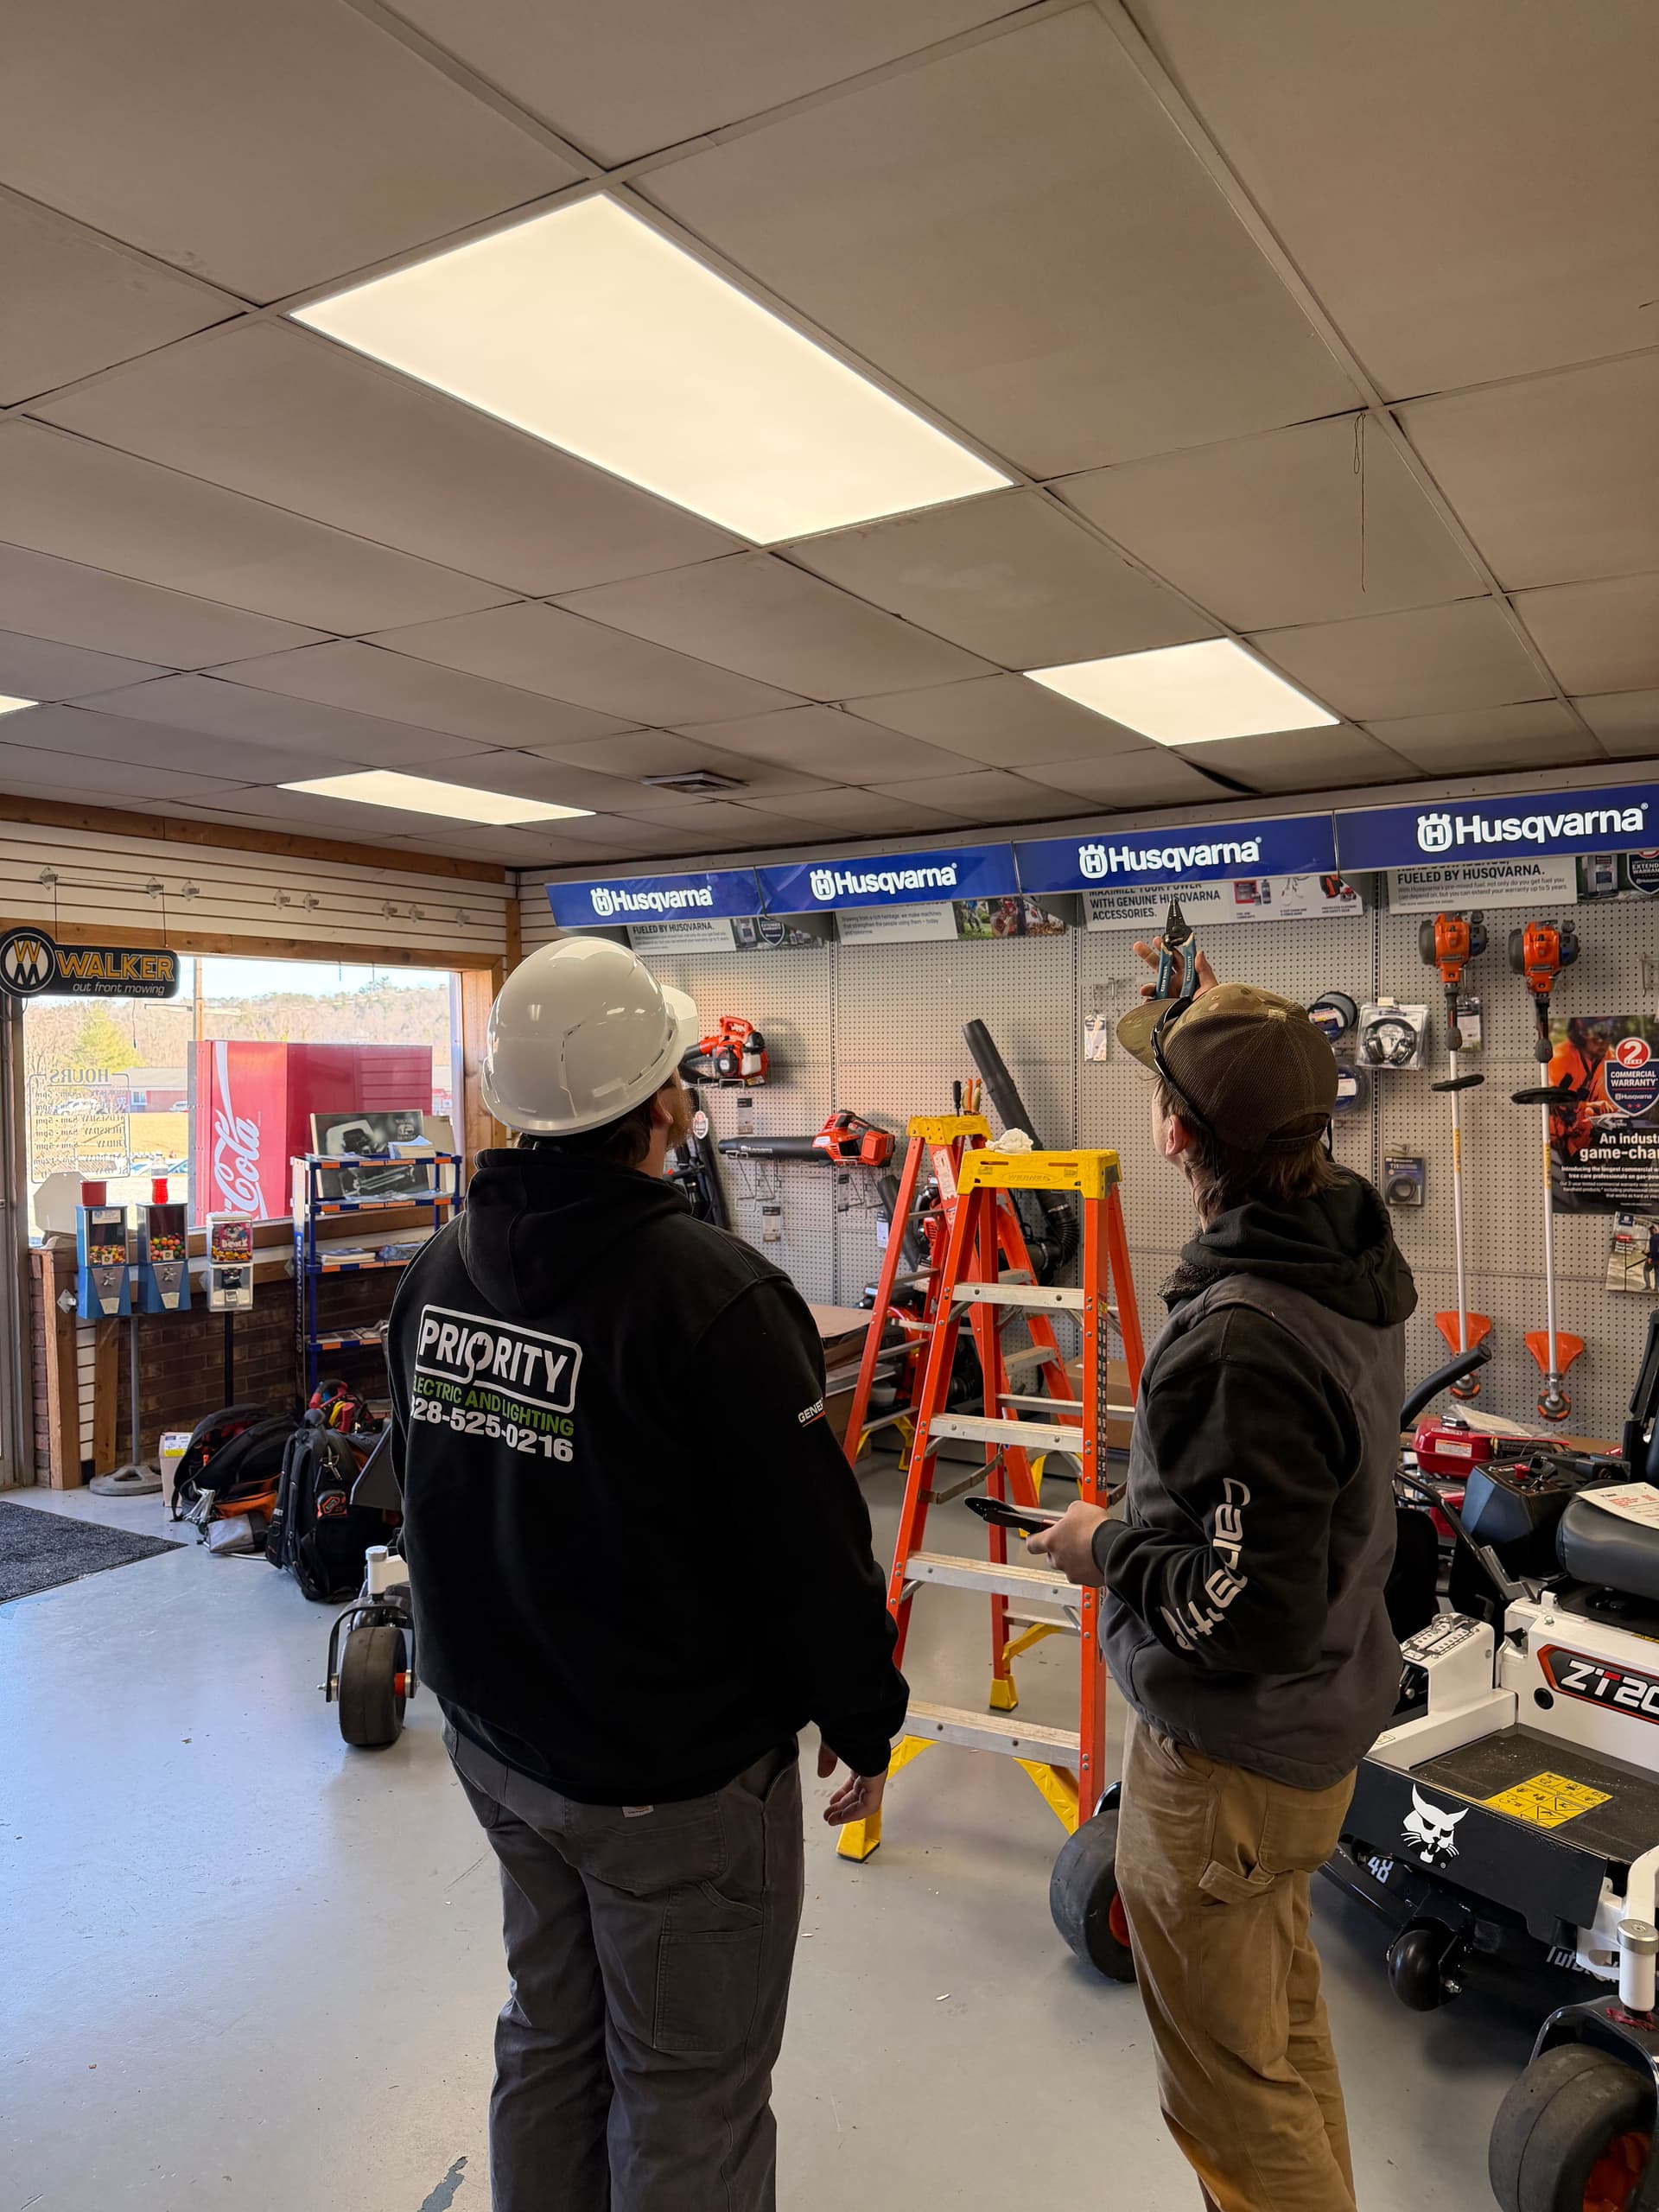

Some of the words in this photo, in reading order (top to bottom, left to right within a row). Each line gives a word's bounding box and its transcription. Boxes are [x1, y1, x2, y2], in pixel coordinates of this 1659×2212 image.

[1398, 872, 1440, 885] FUELED
[1445, 870, 1459, 881] BY
[1463, 865, 1545, 880] HUSQVARNA.
[1090, 898, 1115, 909] WITH
[1116, 894, 1158, 907] GENUINE
[1160, 890, 1221, 905] HUSQVARNA
[1092, 907, 1157, 920] ACCESSORIES.
[632, 925, 658, 934] FUELED
[658, 925, 668, 933] BY
[56, 950, 175, 982] WALKER
[73, 982, 92, 992] out
[94, 981, 122, 993] front
[124, 983, 165, 995] mowing
[1624, 1040, 1643, 1063] 2
[1599, 1133, 1616, 1144] An
[1580, 1145, 1659, 1162] game-cha
[418, 1319, 569, 1394] PRIORITY
[413, 1375, 463, 1404] LECTRIC
[464, 1389, 501, 1413] AND
[501, 1398, 575, 1437] LIGHTING
[798, 1396, 823, 1423] GENE
[410, 1395, 574, 1463] 28-525-0216
